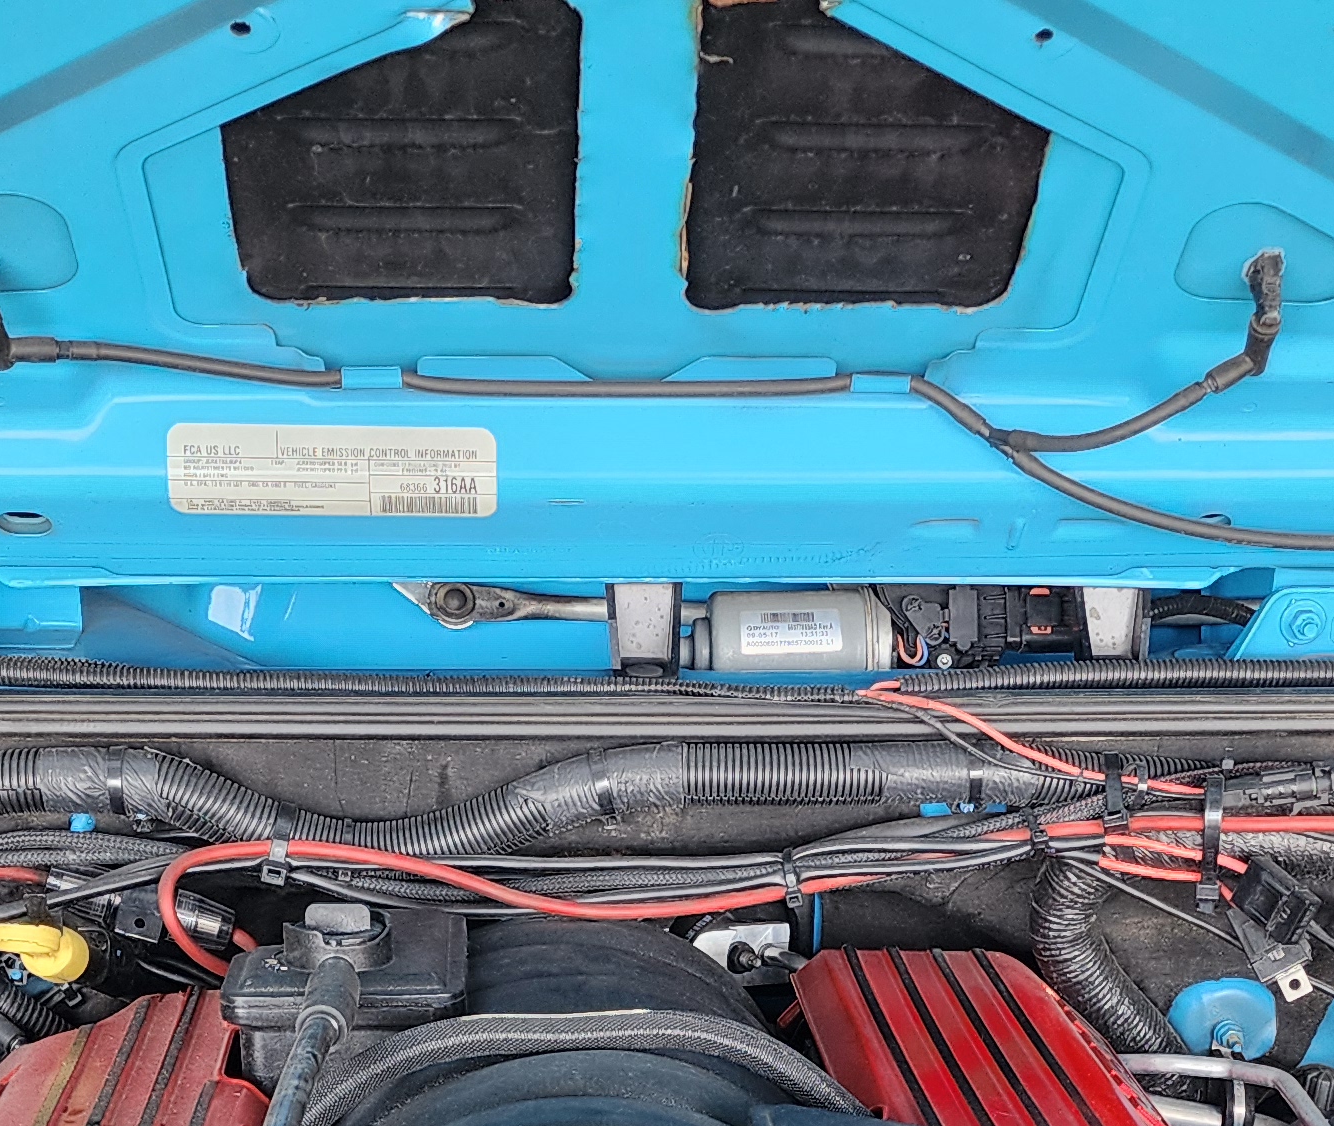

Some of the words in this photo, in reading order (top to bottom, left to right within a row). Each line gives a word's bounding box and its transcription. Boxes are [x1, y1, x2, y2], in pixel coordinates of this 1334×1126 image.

[183, 444, 203, 457] FCA
[205, 444, 219, 457] US
[222, 445, 241, 457] LLC
[279, 446, 318, 459] VEHICLE
[321, 448, 366, 459] EMISSION
[369, 448, 411, 460] CONTROL
[414, 449, 478, 461] INFORMATION
[399, 482, 428, 493] 68366
[433, 476, 478, 494] 316AA
